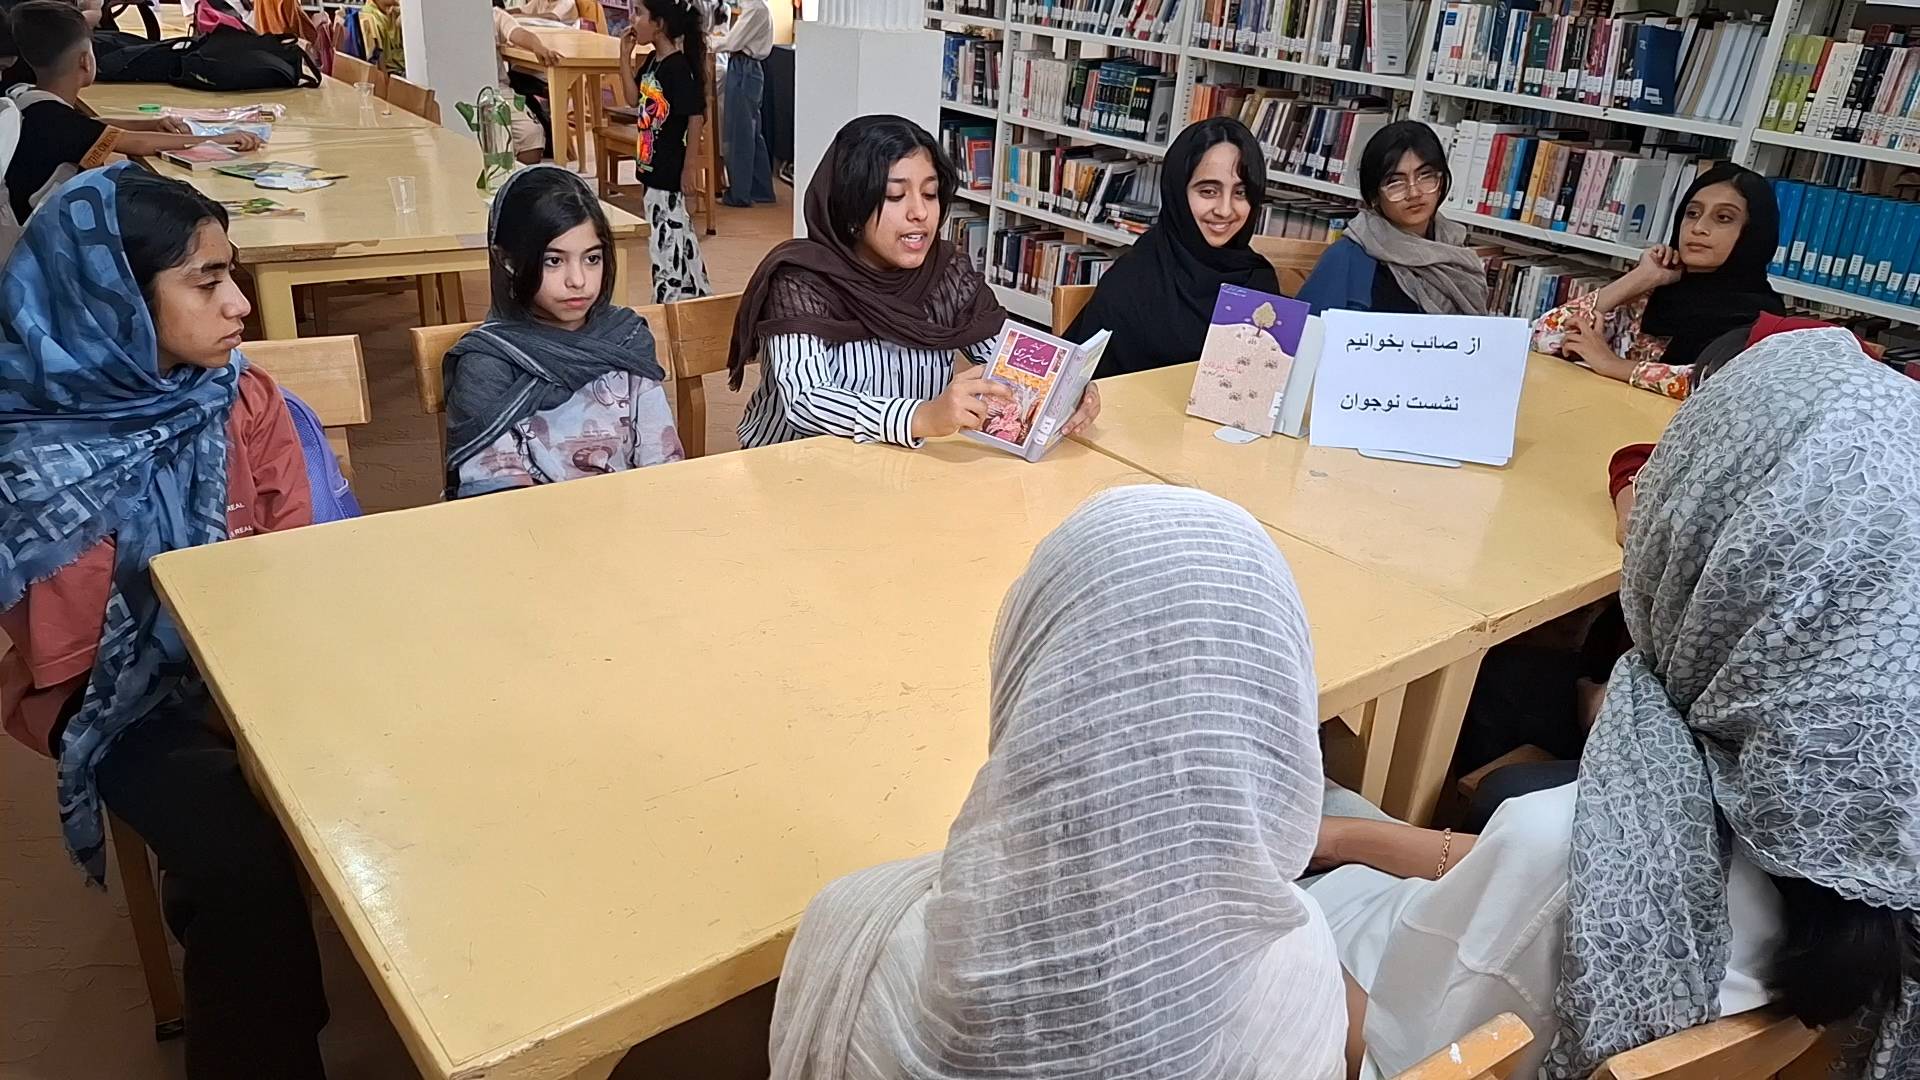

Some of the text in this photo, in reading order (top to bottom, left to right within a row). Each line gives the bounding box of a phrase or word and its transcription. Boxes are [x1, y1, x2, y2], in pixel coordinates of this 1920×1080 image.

[1346, 332, 1404, 353] بخوانیم
[1464, 336, 1480, 355] از
[1340, 392, 1460, 412] نشست نوجوان
[234, 525, 252, 535] REAL
